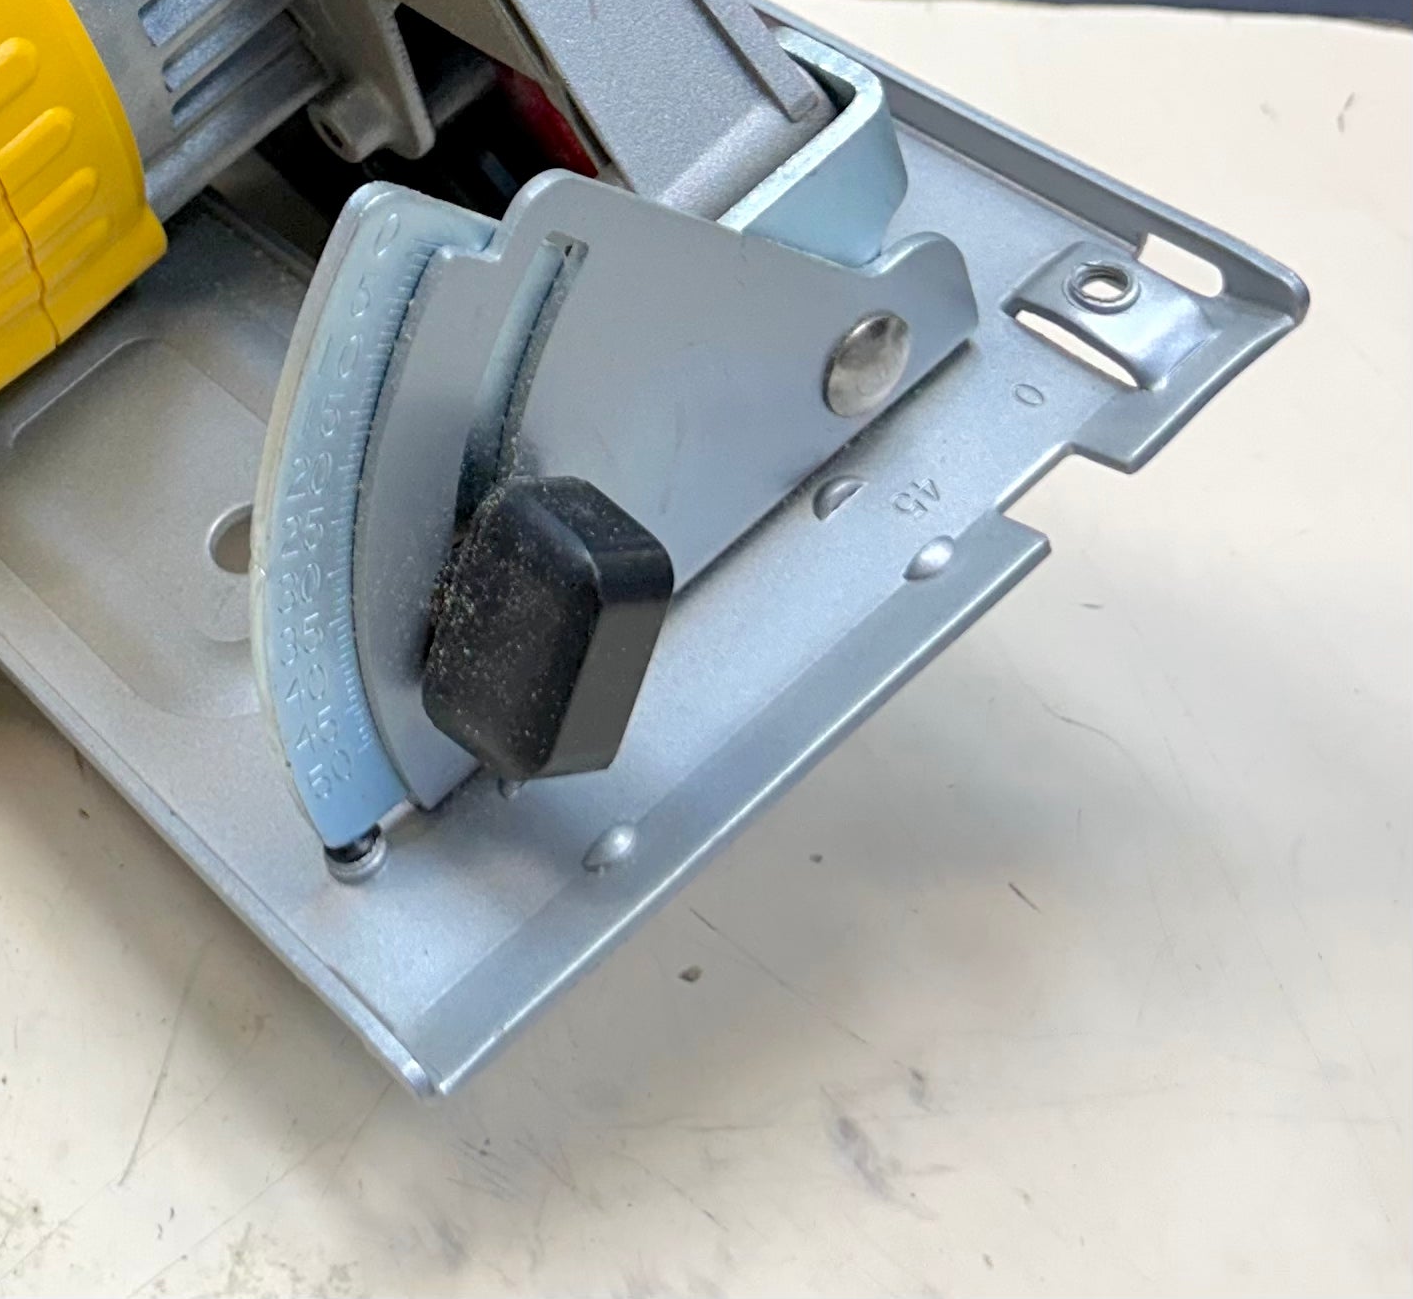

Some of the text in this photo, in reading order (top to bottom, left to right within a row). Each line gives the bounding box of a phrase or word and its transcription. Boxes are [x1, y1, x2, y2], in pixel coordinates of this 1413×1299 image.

[350, 271, 380, 319] 5
[318, 332, 362, 380] 10
[302, 392, 347, 439] 15
[286, 451, 334, 501] 20
[888, 477, 942, 519] 45
[281, 505, 326, 559] 25
[278, 560, 323, 614] 30
[278, 611, 325, 667] 35
[285, 662, 328, 718] 40
[295, 704, 338, 753] 45
[307, 747, 353, 800] 50
